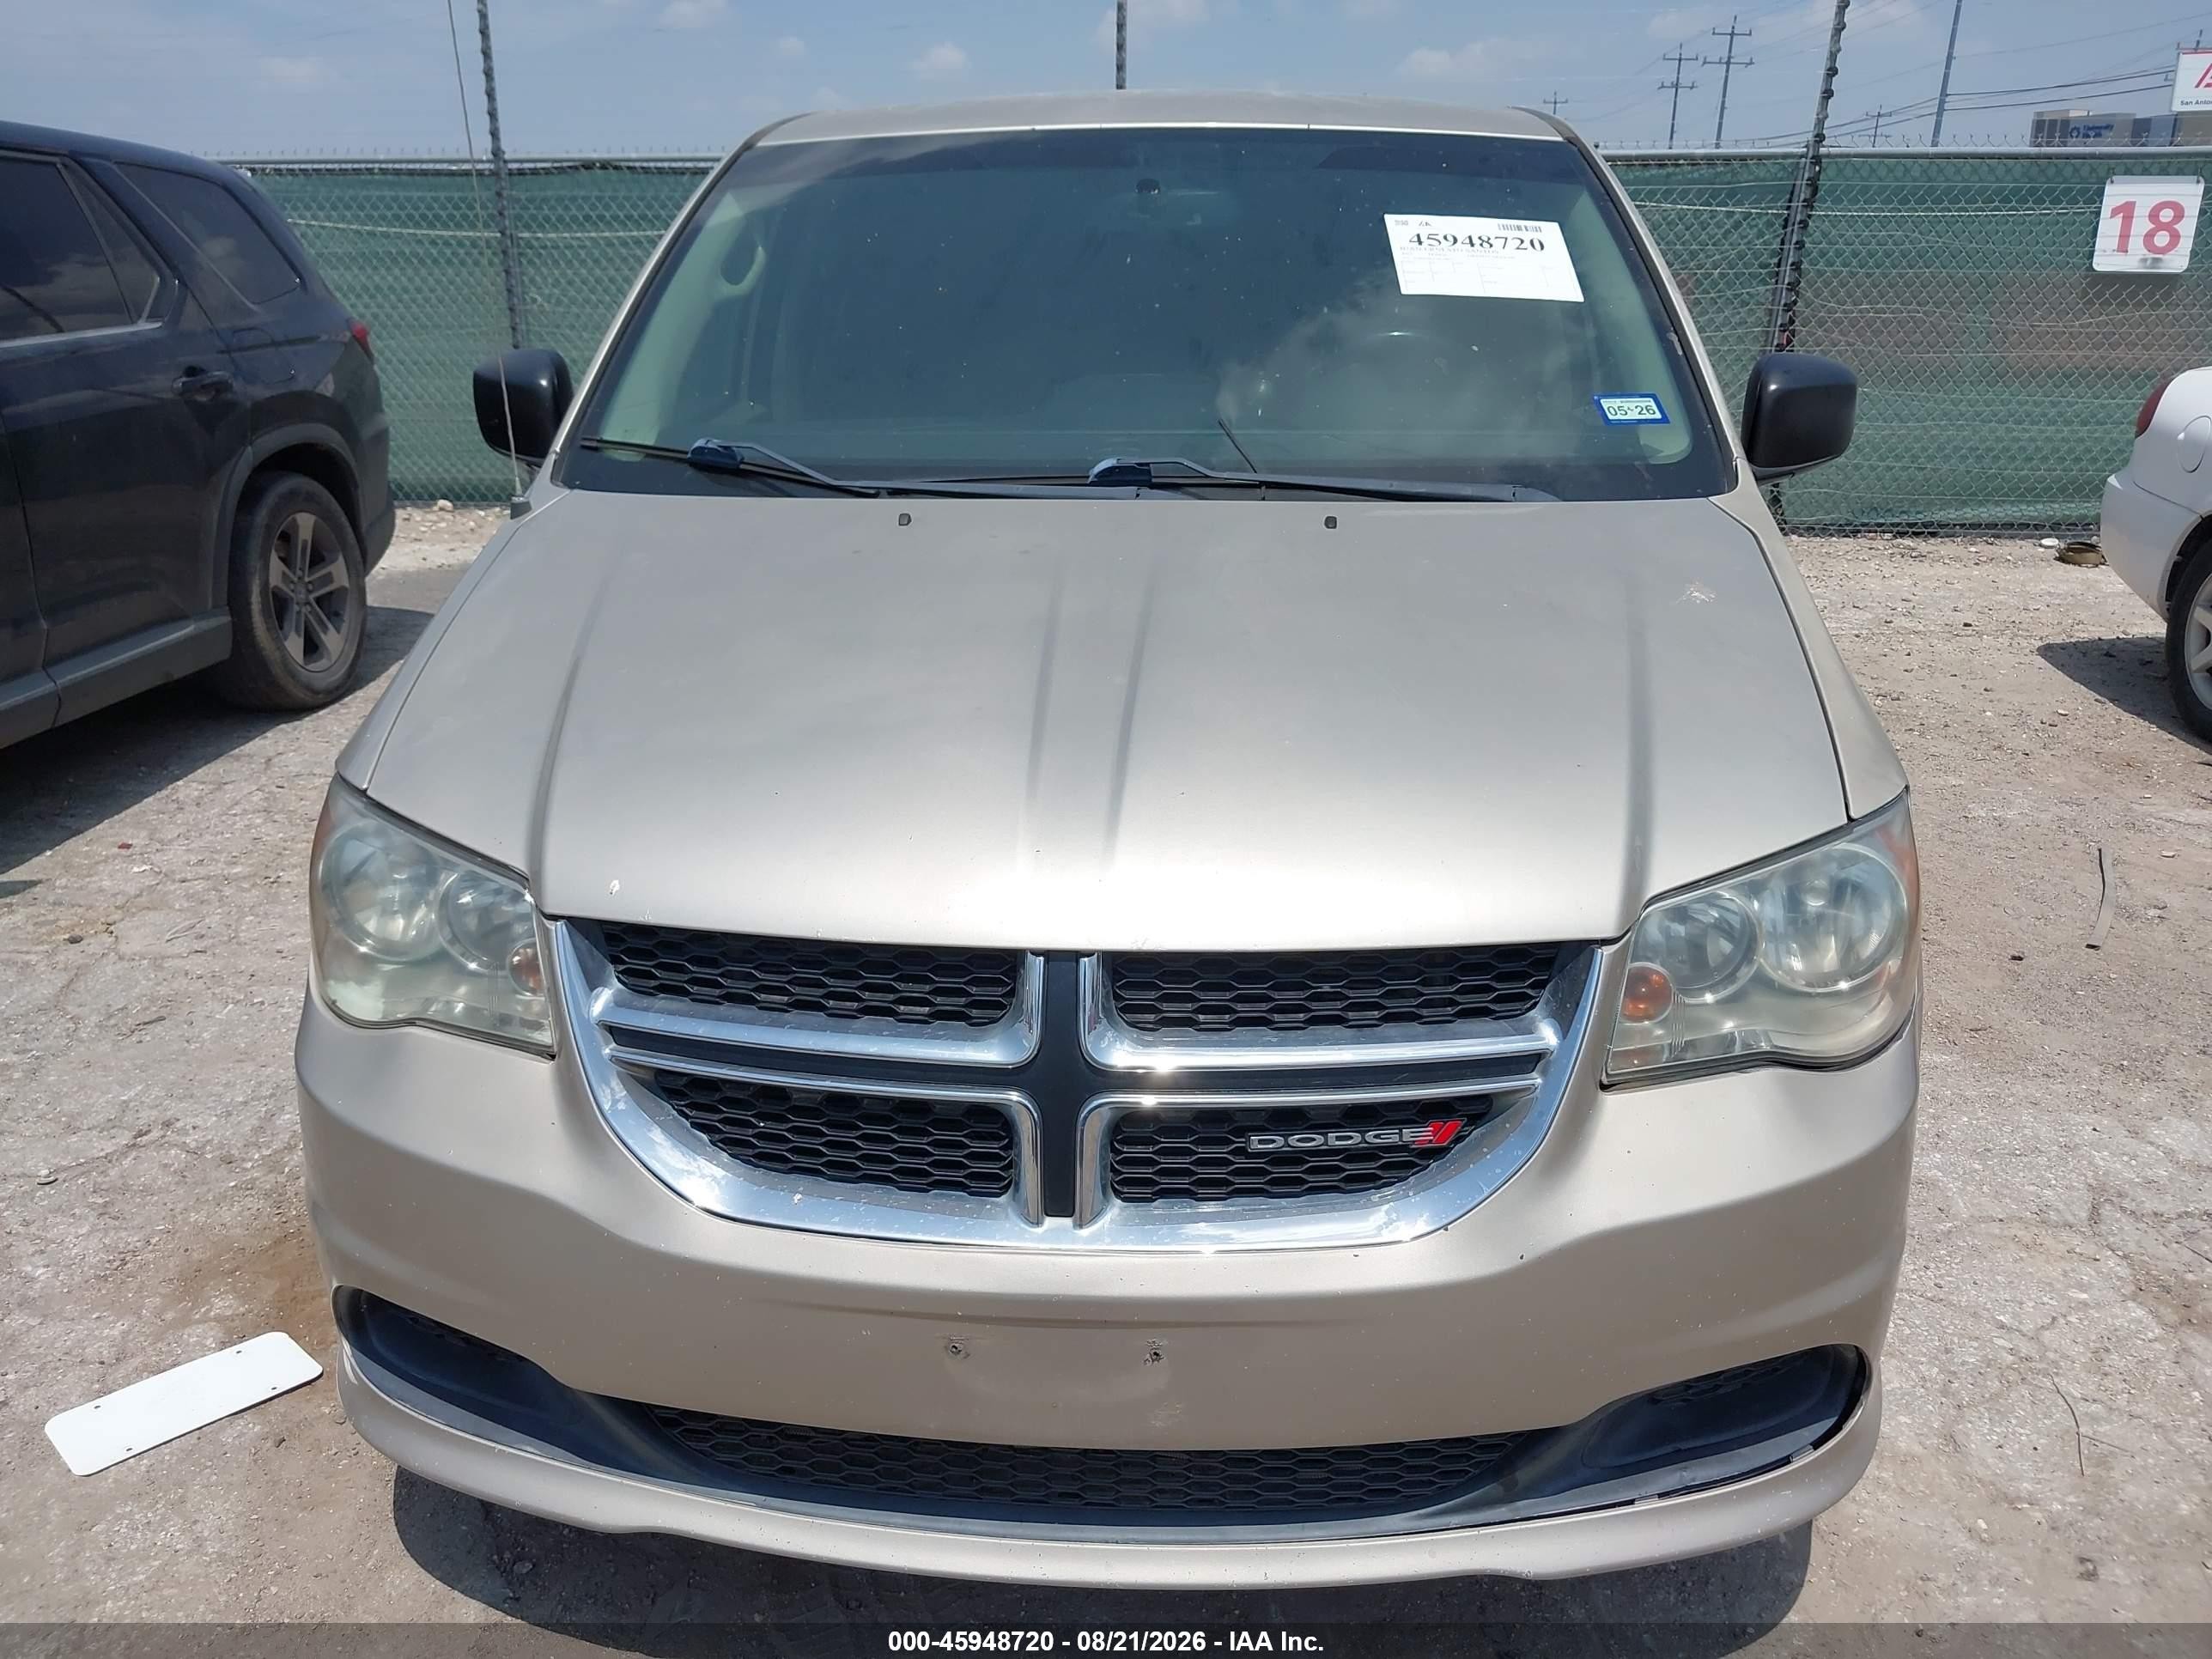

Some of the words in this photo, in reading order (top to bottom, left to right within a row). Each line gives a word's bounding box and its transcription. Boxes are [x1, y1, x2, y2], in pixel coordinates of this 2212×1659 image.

[2109, 200, 2185, 256] 18
[1408, 233, 1546, 252] 45948720
[1249, 1127, 1434, 1149] DODGE
